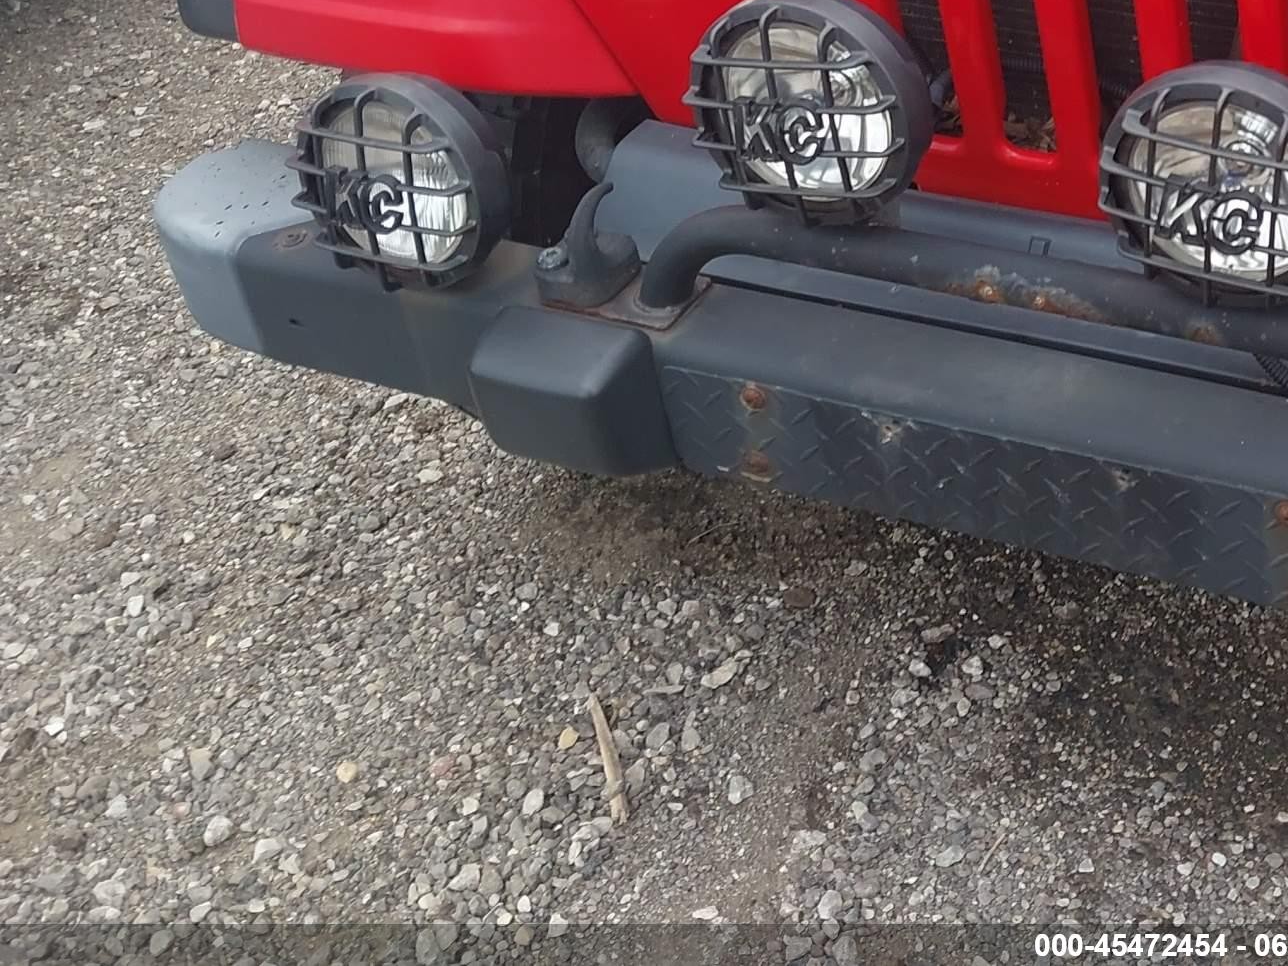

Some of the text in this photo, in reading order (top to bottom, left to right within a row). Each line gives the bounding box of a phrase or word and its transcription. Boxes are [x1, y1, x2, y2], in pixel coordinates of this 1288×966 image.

[733, 97, 825, 165] KC
[325, 165, 405, 235] KC
[1154, 173, 1263, 255] KC
